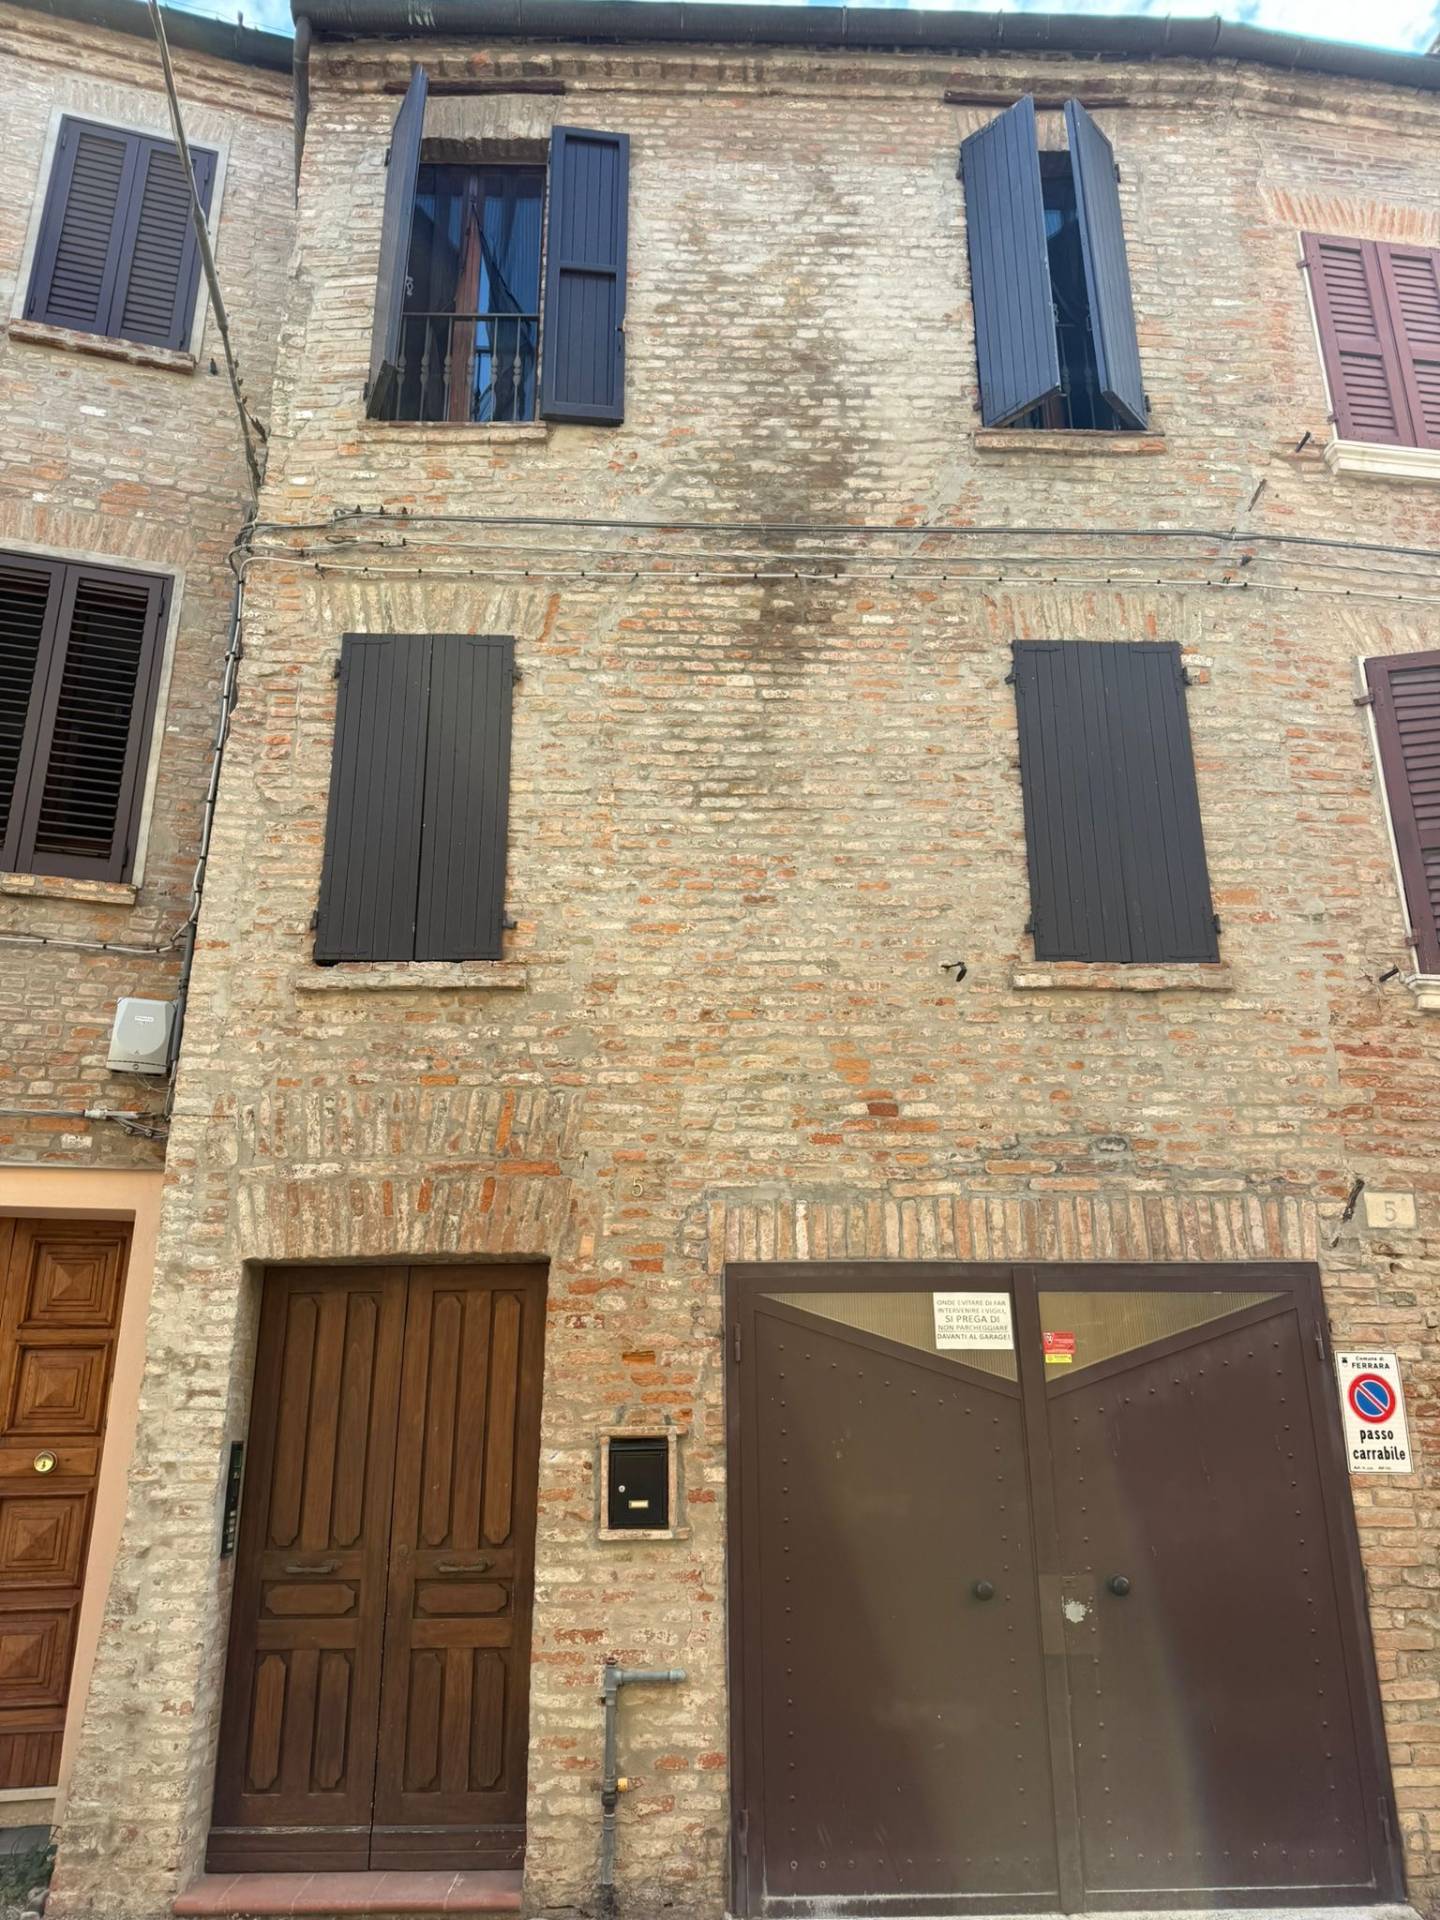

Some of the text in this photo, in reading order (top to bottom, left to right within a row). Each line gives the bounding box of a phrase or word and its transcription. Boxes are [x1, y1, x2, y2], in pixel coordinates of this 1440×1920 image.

[631, 1175, 643, 1197] 5
[945, 1314, 1000, 1323] SI PREGA DI
[1359, 1429, 1394, 1444] passo
[1352, 1445, 1406, 1461] carrabile
